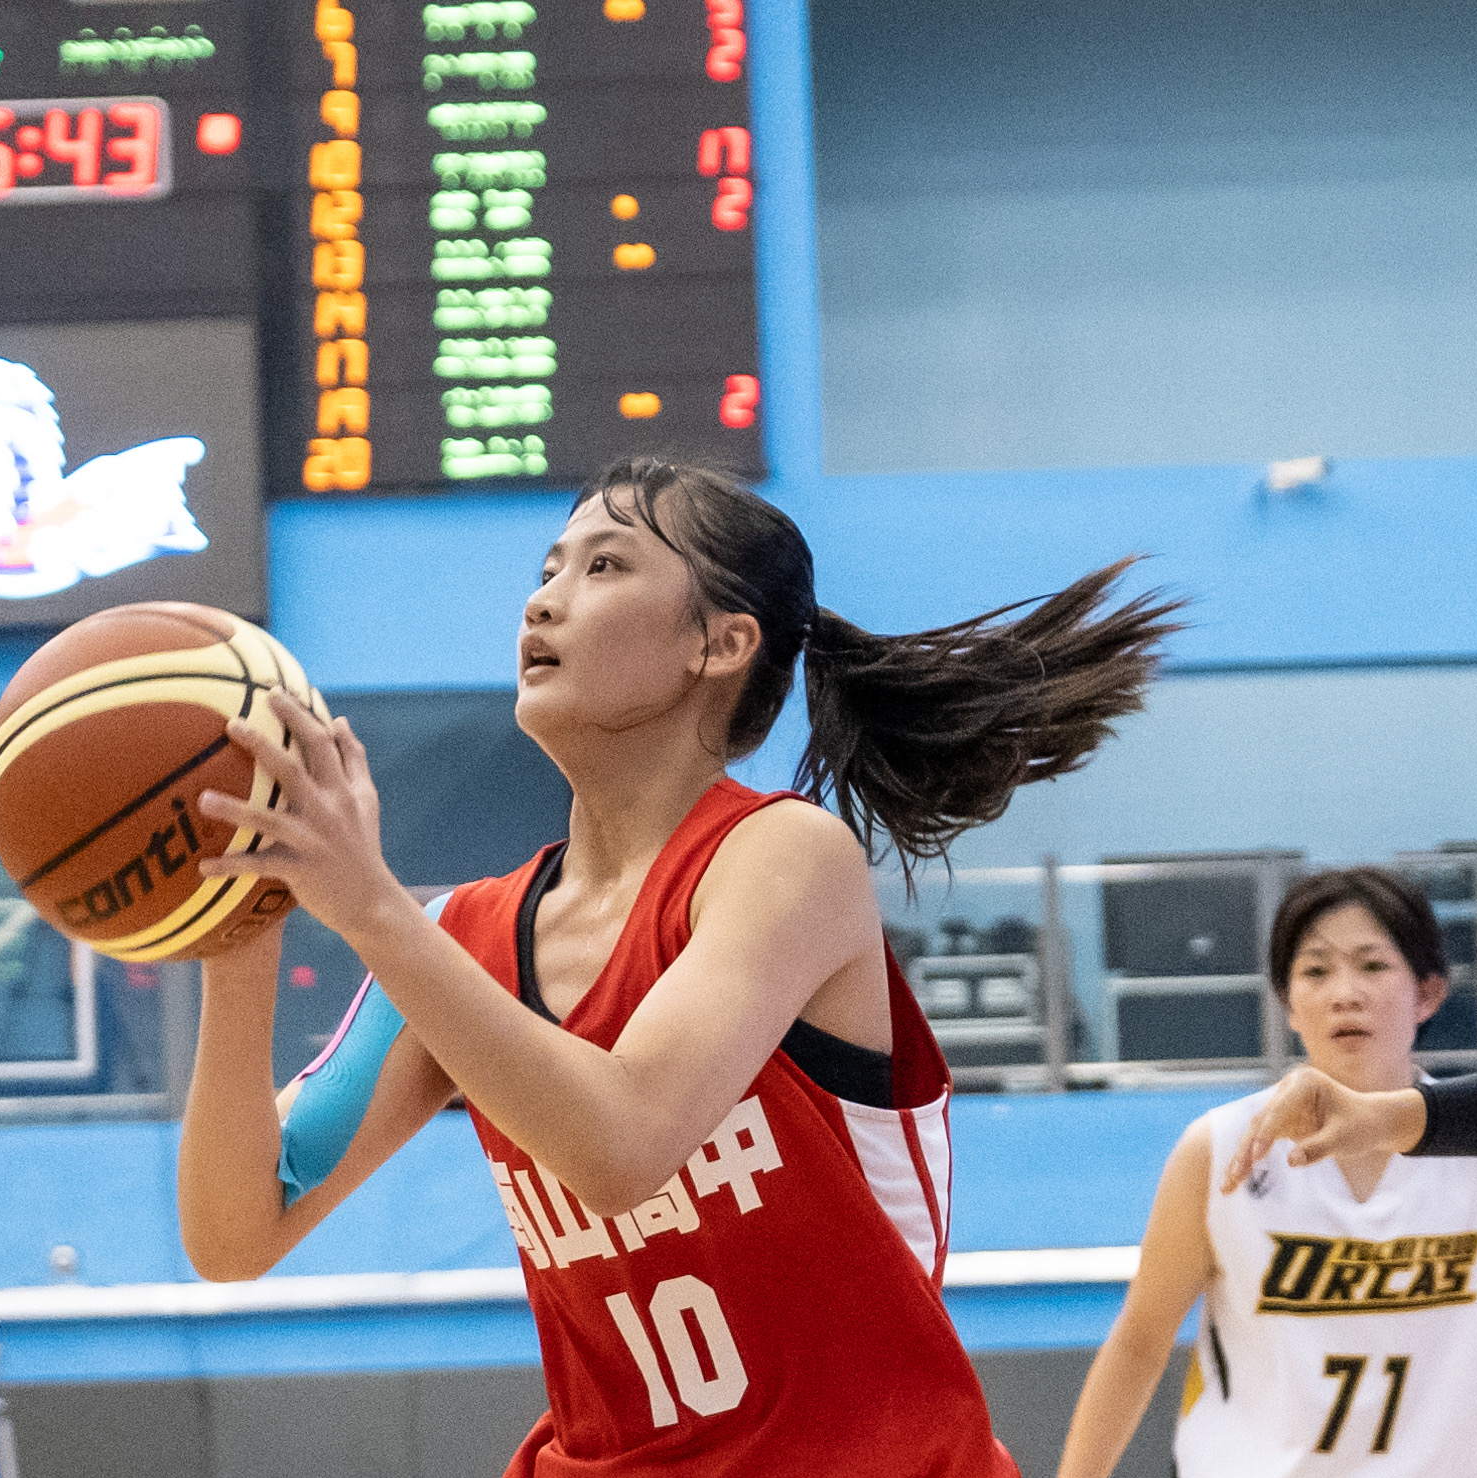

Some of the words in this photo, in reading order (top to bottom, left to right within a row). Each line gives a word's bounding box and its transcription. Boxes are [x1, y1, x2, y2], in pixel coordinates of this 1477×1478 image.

[324, 41, 357, 89] 7
[706, 28, 746, 82] 2
[712, 177, 753, 230] 2
[720, 374, 760, 429] 2
[57, 798, 200, 928] conti
[1261, 1236, 1474, 1302] ORCAS
[605, 1275, 749, 1428] 10
[1315, 1355, 1412, 1454] 71
